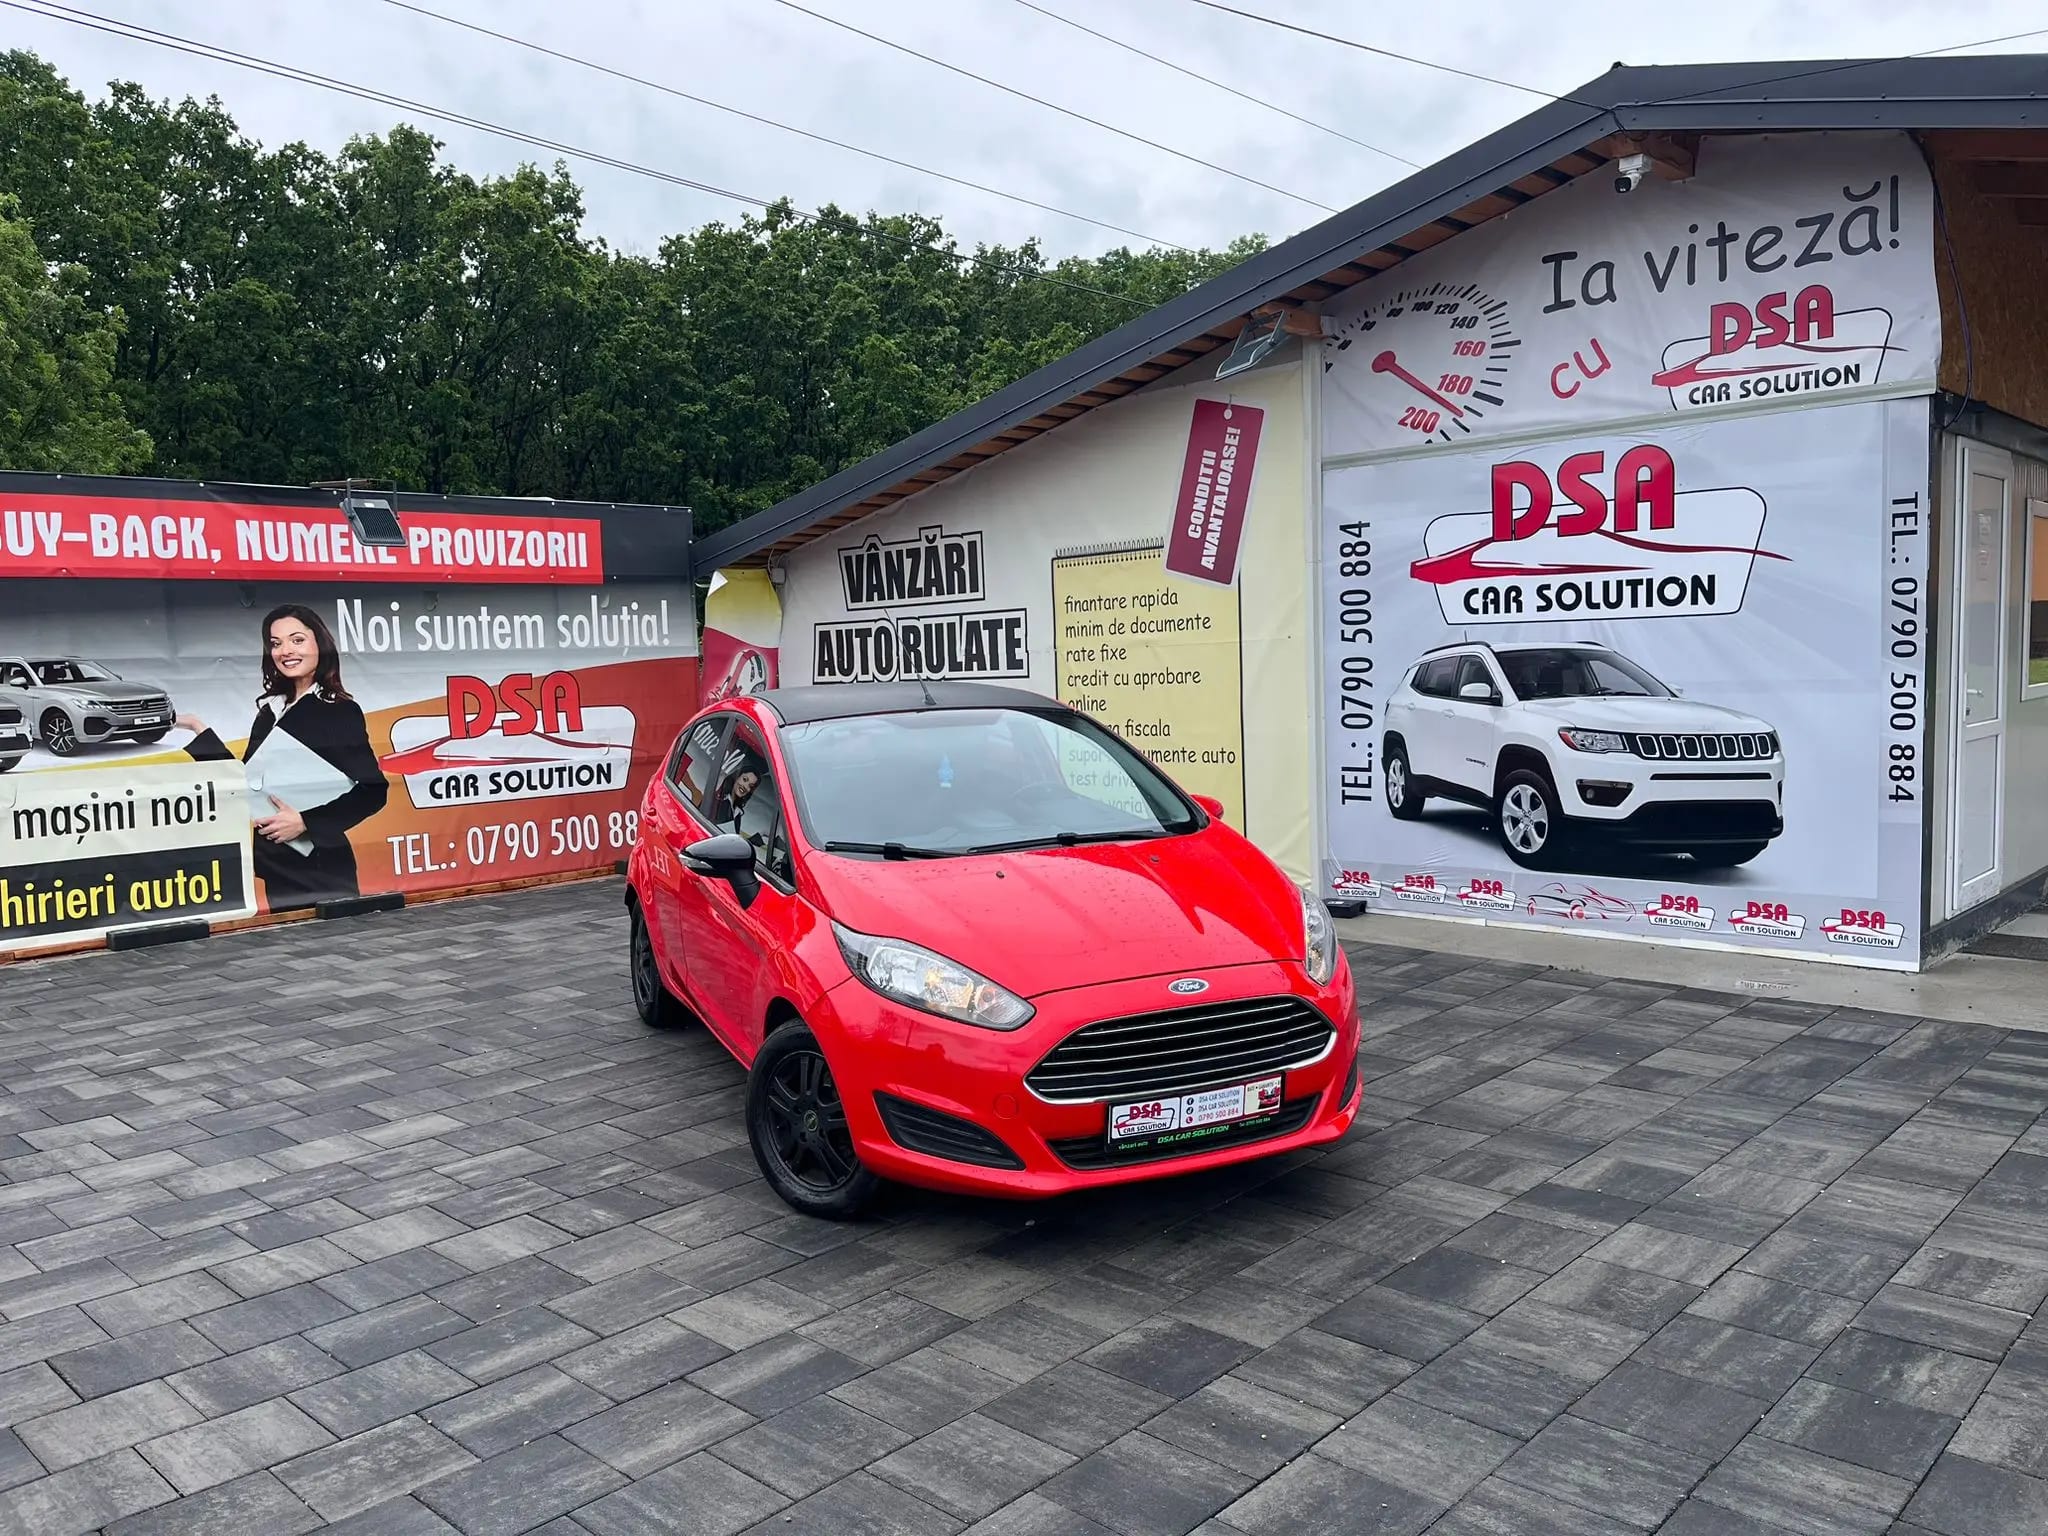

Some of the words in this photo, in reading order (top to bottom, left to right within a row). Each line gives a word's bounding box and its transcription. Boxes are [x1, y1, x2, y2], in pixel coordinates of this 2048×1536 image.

[1541, 251, 1617, 314] Ia
[1644, 175, 1900, 293] viteză!
[1411, 301, 1434, 312] 100
[1434, 303, 1460, 315] 120
[1449, 316, 1479, 329] 140
[1710, 284, 1834, 355] DSA
[1452, 340, 1487, 357] 160
[1550, 337, 1612, 400] cu
[1437, 373, 1474, 395] 180
[1688, 385, 1730, 406] CAR
[1739, 363, 1860, 400] SOLUTION
[1398, 406, 1441, 433] 200
[1188, 450, 1216, 539] CONDITII
[1201, 426, 1240, 571] AVANTAJOASE!
[1492, 444, 1675, 542] DSA
[0, 511, 221, 563] UY-BACK,
[409, 527, 588, 567] PROVIZORII
[1339, 520, 1371, 578] 884
[844, 534, 980, 603] VÂNZĂRI
[1065, 595, 1127, 613] finantare
[1132, 587, 1178, 612] rapida
[1464, 586, 1523, 615] CAR
[1536, 574, 1716, 613] SOLUTION
[336, 599, 402, 652] Noi
[415, 606, 545, 650] suntem
[557, 595, 669, 656] soluția!
[1065, 621, 1104, 638] minim
[1108, 618, 1126, 635] de
[1130, 614, 1211, 634] documente
[1340, 589, 1372, 655] 500
[1891, 577, 1918, 658] 0790
[1066, 648, 1095, 663] rate
[1100, 643, 1127, 662] fixe
[1067, 668, 1108, 687] credit
[1114, 674, 1129, 686] cu
[1134, 667, 1202, 690] aprobare
[447, 671, 583, 739] DSA
[1340, 657, 1373, 730] 0790
[1890, 671, 1916, 731] 500
[1125, 719, 1171, 738] fiscala
[1202, 747, 1236, 764] auto
[429, 773, 479, 800] CAR
[489, 763, 612, 796] SOLUTION
[1888, 743, 1915, 803] 884
[13, 789, 135, 844] mașini
[151, 781, 217, 826] noi!
[387, 832, 457, 875] TEL.:
[466, 820, 539, 866] 0790
[550, 814, 600, 856] 500
[608, 810, 638, 848] 88
[1342, 870, 1370, 884] DSA
[1405, 875, 1435, 890] DSA
[1471, 878, 1503, 897] DSA
[0, 873, 115, 928] hirieri
[130, 860, 222, 911] auto!
[1351, 889, 1377, 897] SOLUTION
[1413, 894, 1441, 903] SOLUTION
[1479, 900, 1510, 909] SOLUTION
[1661, 894, 1699, 913] DSA
[1669, 918, 1706, 928] SOLUTION
[1747, 901, 1788, 922] DSA
[1841, 908, 1885, 930] DSA
[1740, 925, 1755, 933] CAR
[1757, 926, 1796, 937] SOLUTION
[1833, 933, 1849, 942] CAR
[1851, 935, 1894, 946] SOLUTION
[1178, 981, 1201, 991] Ford
[1130, 1102, 1162, 1120] DSA
[1123, 1126, 1135, 1134] CAR
[1136, 1121, 1167, 1131] SOLUTION
[1157, 1135, 1174, 1144] DSA
[1175, 1131, 1192, 1141] CAR
[1192, 1124, 1230, 1139] SOLUTION
